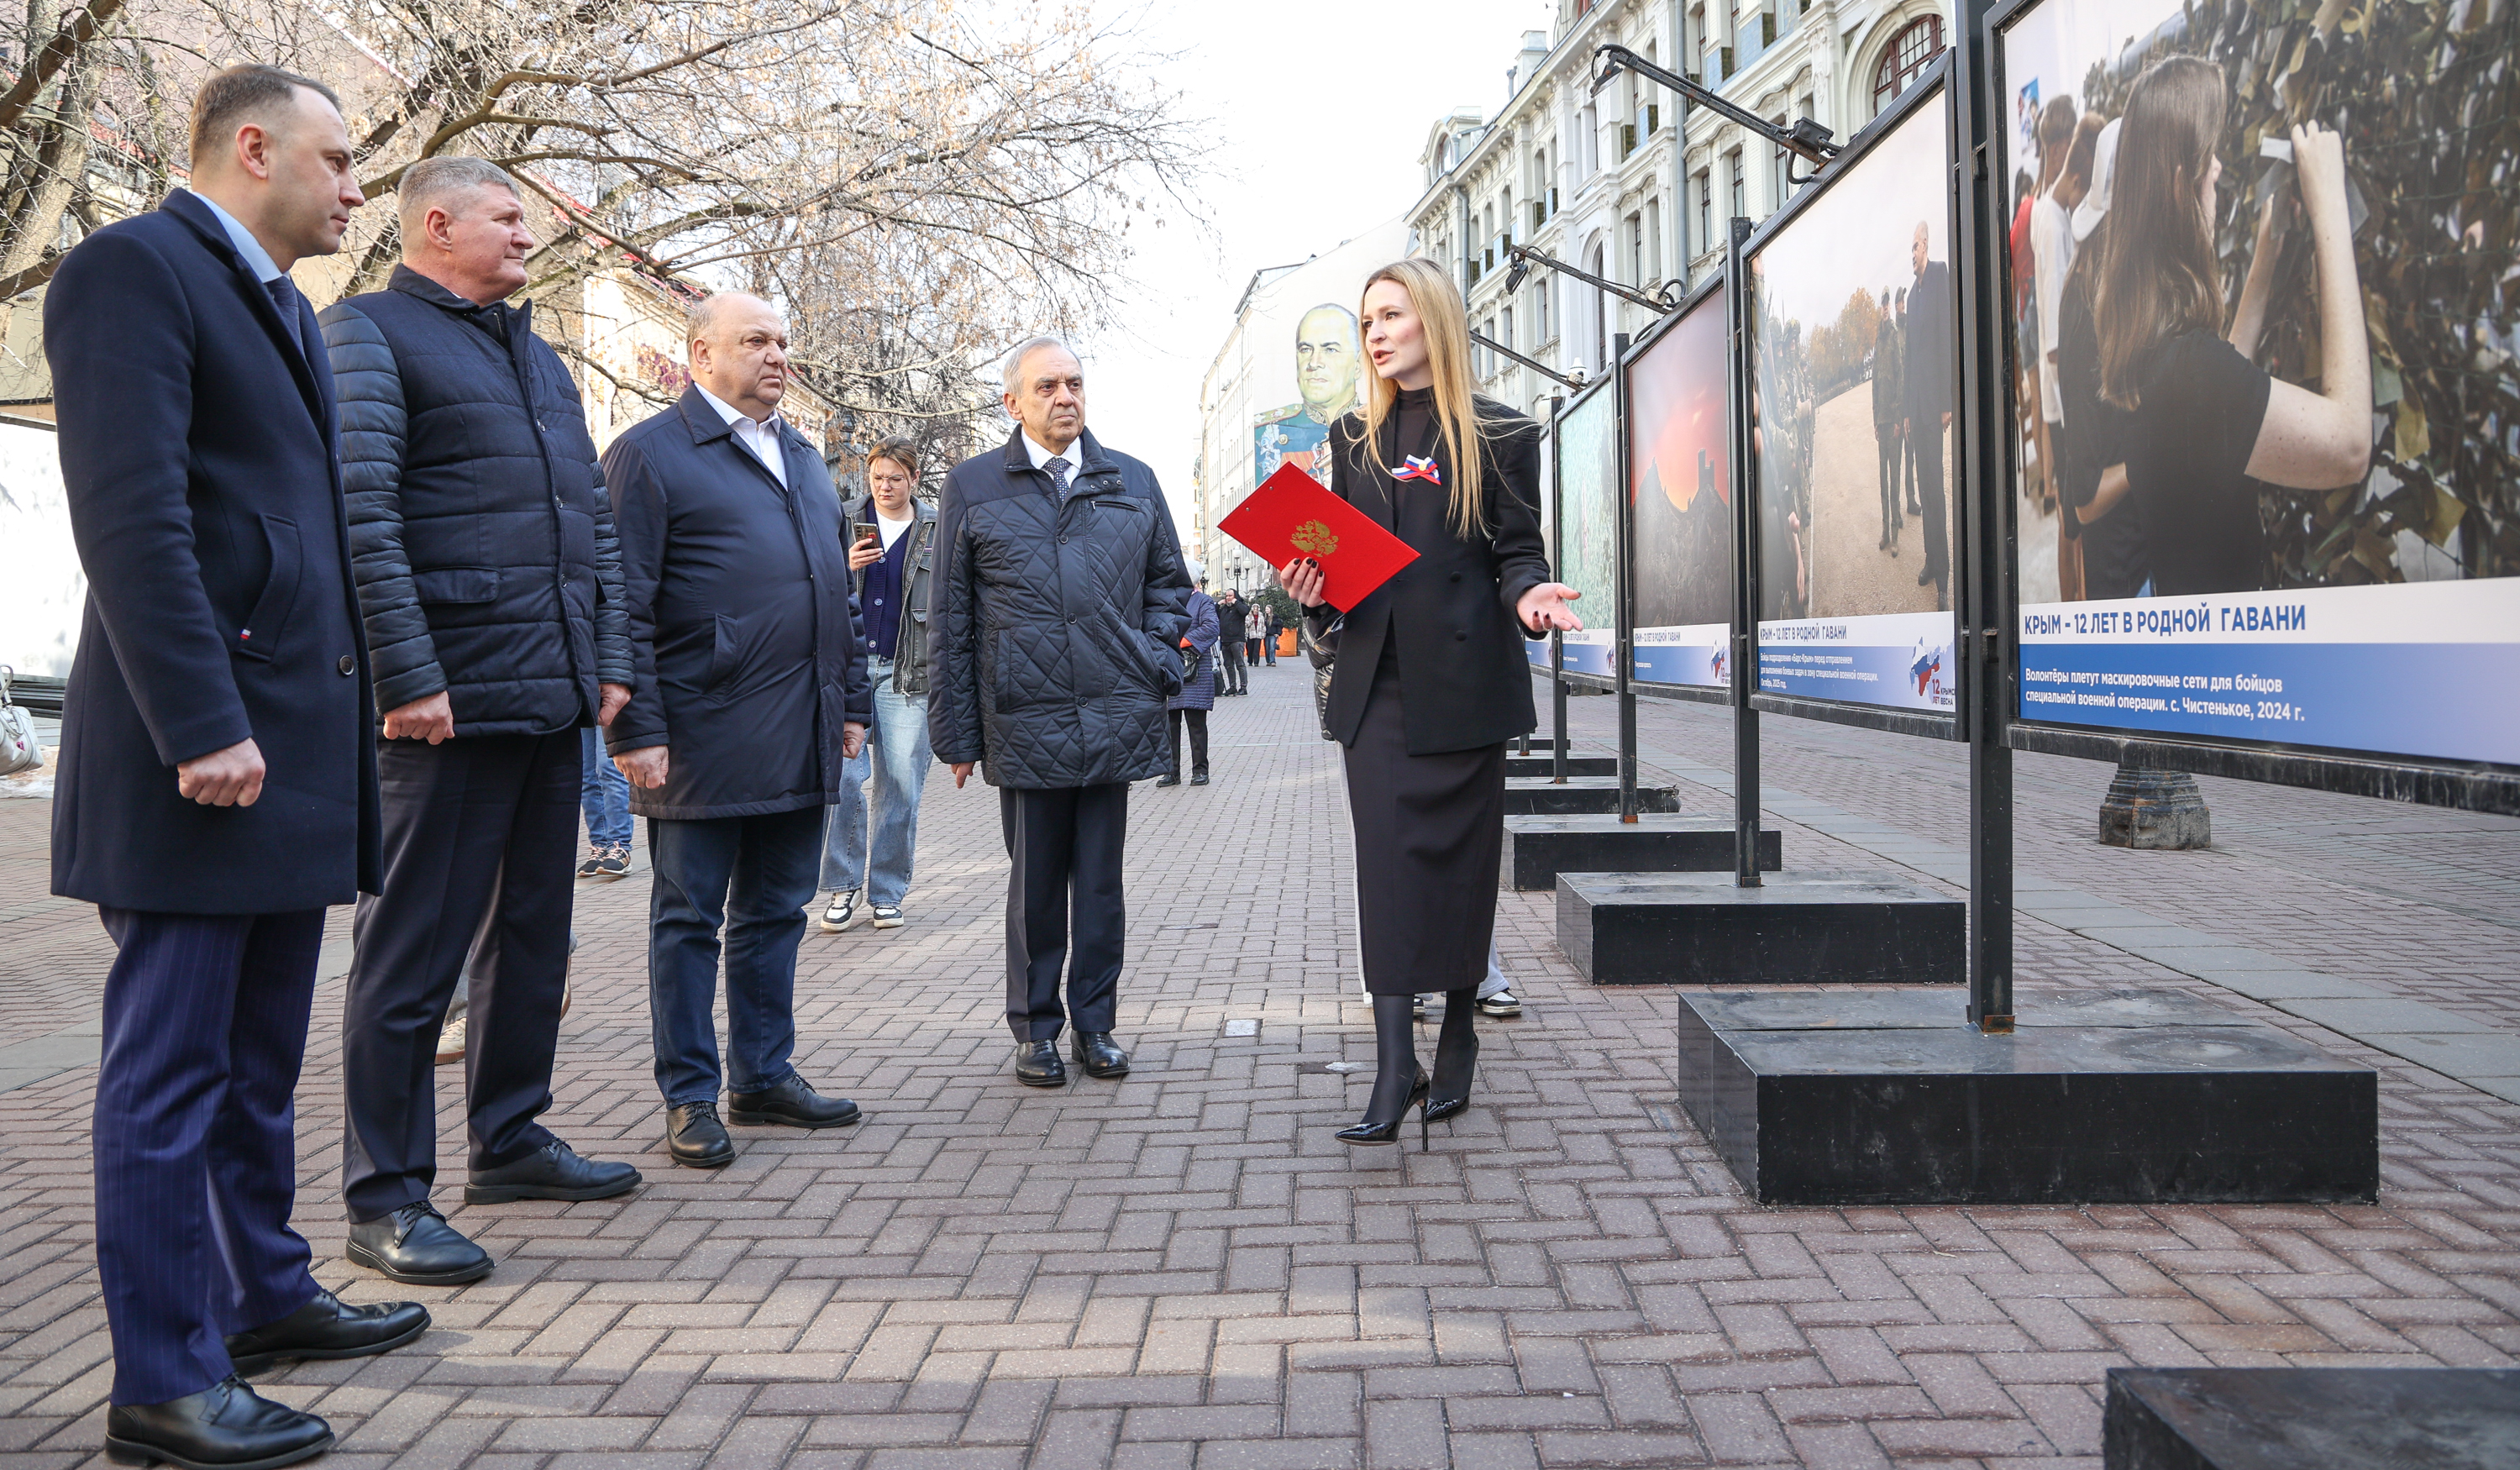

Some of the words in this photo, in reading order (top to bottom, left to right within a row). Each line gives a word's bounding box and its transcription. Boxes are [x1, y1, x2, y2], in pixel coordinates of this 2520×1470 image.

[1760, 627, 1772, 640] КРЫМ
[1776, 627, 1781, 640] 12
[1782, 627, 1791, 640] ЛЕТ
[1792, 627, 1796, 640] В
[1797, 622, 1819, 642] РОДНОЙ
[1822, 625, 1847, 639] ГАВАНИ
[2024, 614, 2061, 634] КРЫМ
[2074, 613, 2087, 634] 12
[2091, 612, 2118, 633] ЛЕТ
[2123, 612, 2133, 633] В
[2137, 601, 2210, 637] РОДНОЙ
[2221, 605, 2306, 631] ГАВАНИ
[1932, 679, 1940, 695] 12
[2025, 668, 2069, 685] Волонтёры
[2071, 671, 2099, 686] плетут
[2102, 672, 2180, 689] маскировочные
[2182, 675, 2208, 689] сети
[2210, 676, 2232, 692] для
[2235, 674, 2282, 695] бойцов
[2025, 690, 2076, 704] специальной
[2078, 692, 2116, 707] военной
[2118, 696, 2168, 712] операции.
[2171, 699, 2180, 712] с.
[2182, 697, 2255, 721] Чистенькое,
[2257, 701, 2291, 720] 2024
[2294, 706, 2305, 722] г.
